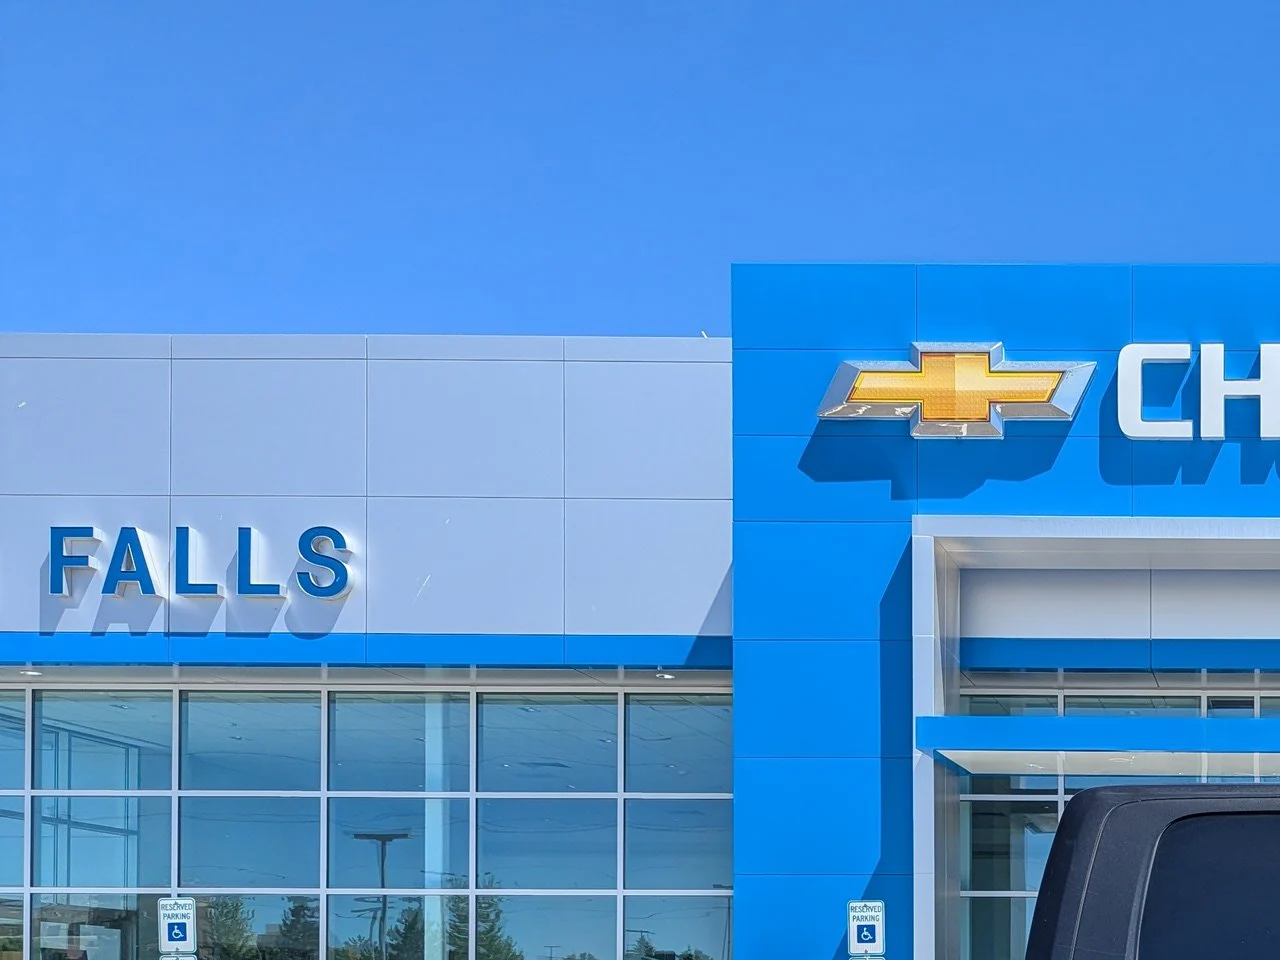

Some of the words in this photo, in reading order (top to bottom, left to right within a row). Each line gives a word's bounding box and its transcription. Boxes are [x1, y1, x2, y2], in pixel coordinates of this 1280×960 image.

[49, 526, 349, 598] FALLS
[161, 903, 193, 911] RESERVED
[850, 905, 882, 913] RESERVED
[163, 912, 191, 920] PARKING
[852, 914, 880, 922] PARKING
